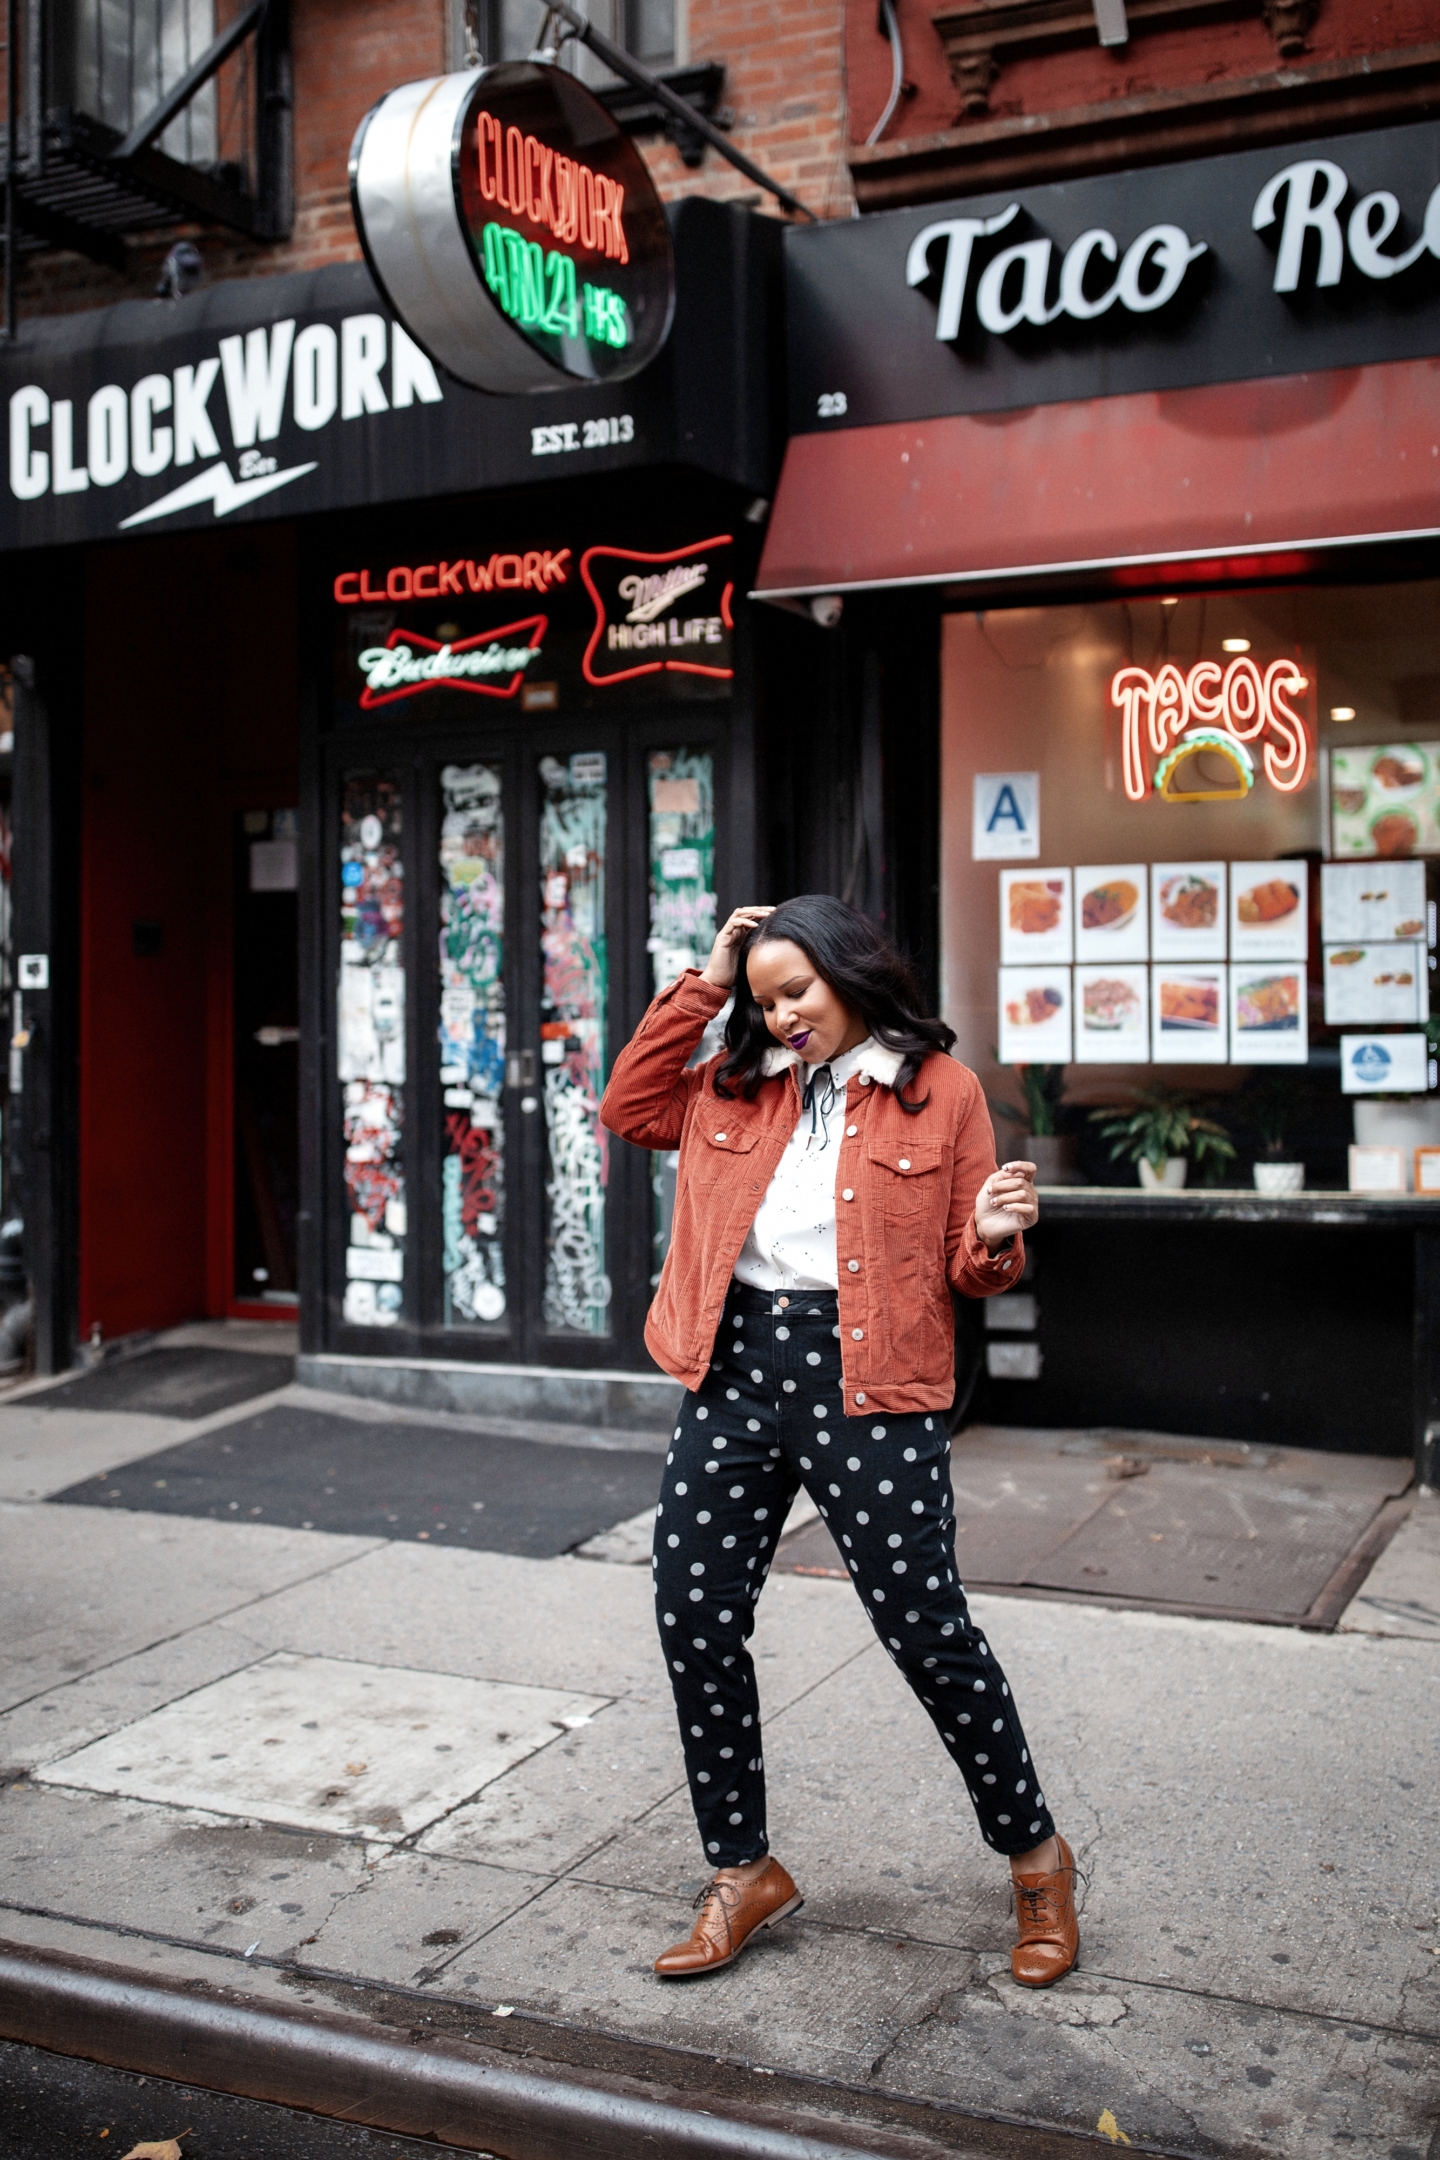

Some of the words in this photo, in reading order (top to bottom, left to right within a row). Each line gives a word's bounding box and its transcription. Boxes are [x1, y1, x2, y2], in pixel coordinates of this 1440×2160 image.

[478, 110, 629, 265] CLOCKWORK
[906, 203, 1208, 341] Taco
[584, 282, 627, 348] HRS
[817, 391, 848, 417] 23
[531, 423, 581, 456] EST.
[583, 415, 635, 448] 2013
[334, 548, 571, 603] CLOCKWORK
[608, 623, 666, 651] HIGH
[669, 616, 722, 646] LIFE
[358, 642, 542, 690] Budweiser
[1112, 656, 1308, 800] TACOS
[986, 783, 1026, 832] A
